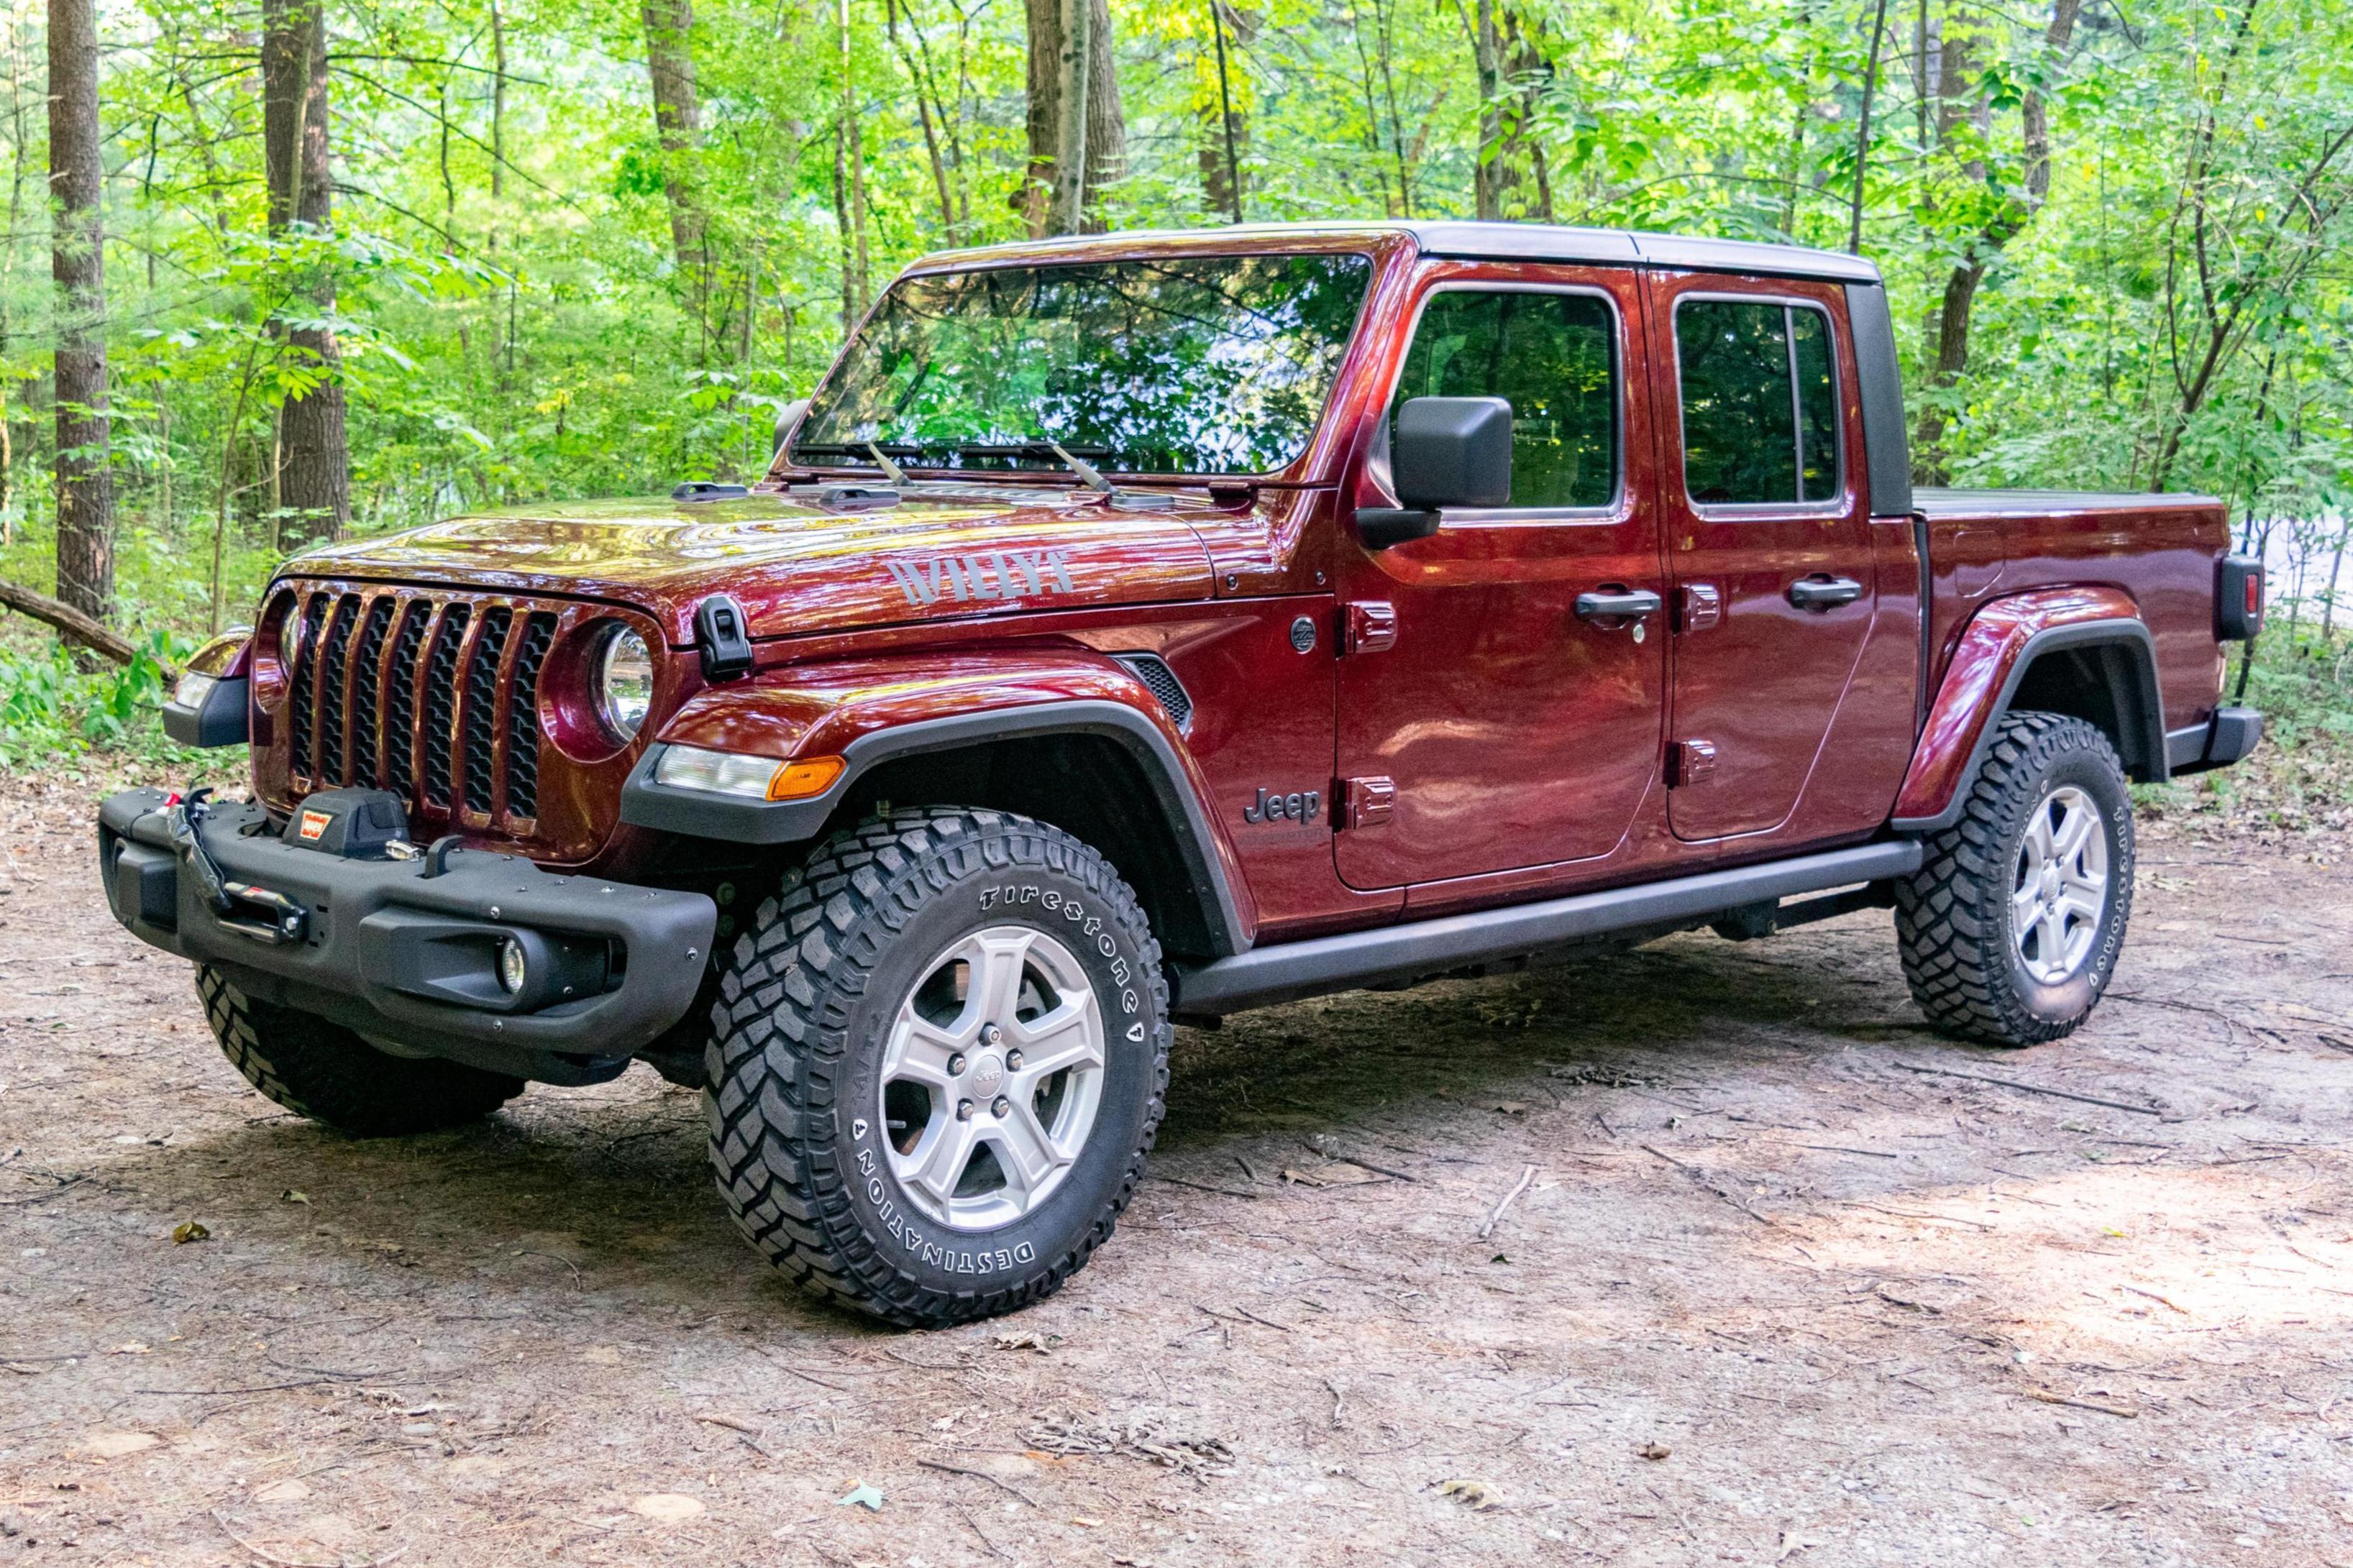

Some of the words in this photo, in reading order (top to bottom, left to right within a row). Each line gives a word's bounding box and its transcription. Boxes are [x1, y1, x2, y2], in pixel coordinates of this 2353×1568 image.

[883, 551, 1073, 605] WILLYS
[1243, 788, 1320, 825] Jeep
[979, 886, 1138, 1014] Firestone
[857, 1149, 1035, 1274] DESTINATION
